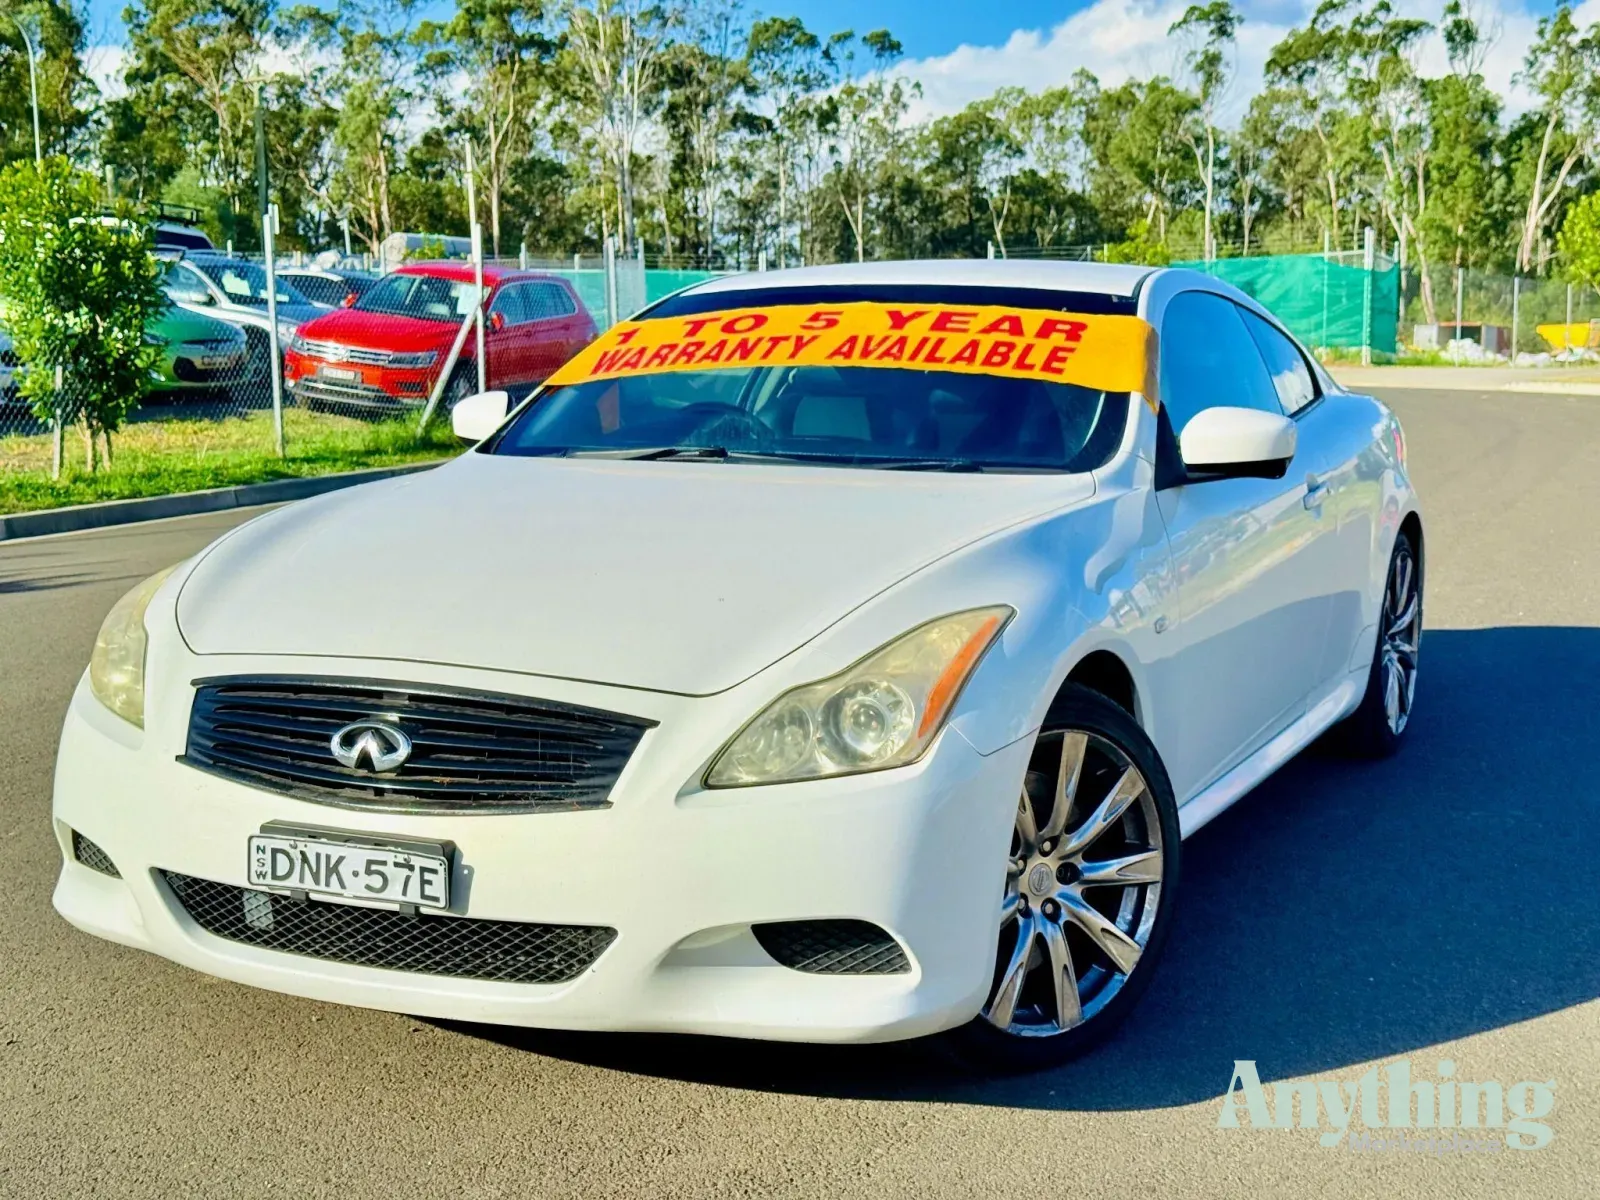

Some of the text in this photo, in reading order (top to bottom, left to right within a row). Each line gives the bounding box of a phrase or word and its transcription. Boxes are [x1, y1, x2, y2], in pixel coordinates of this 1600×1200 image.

[616, 310, 1088, 346] 1 TO 5 YEAR
[590, 334, 1077, 376] WARRANTY AVAILABLE
